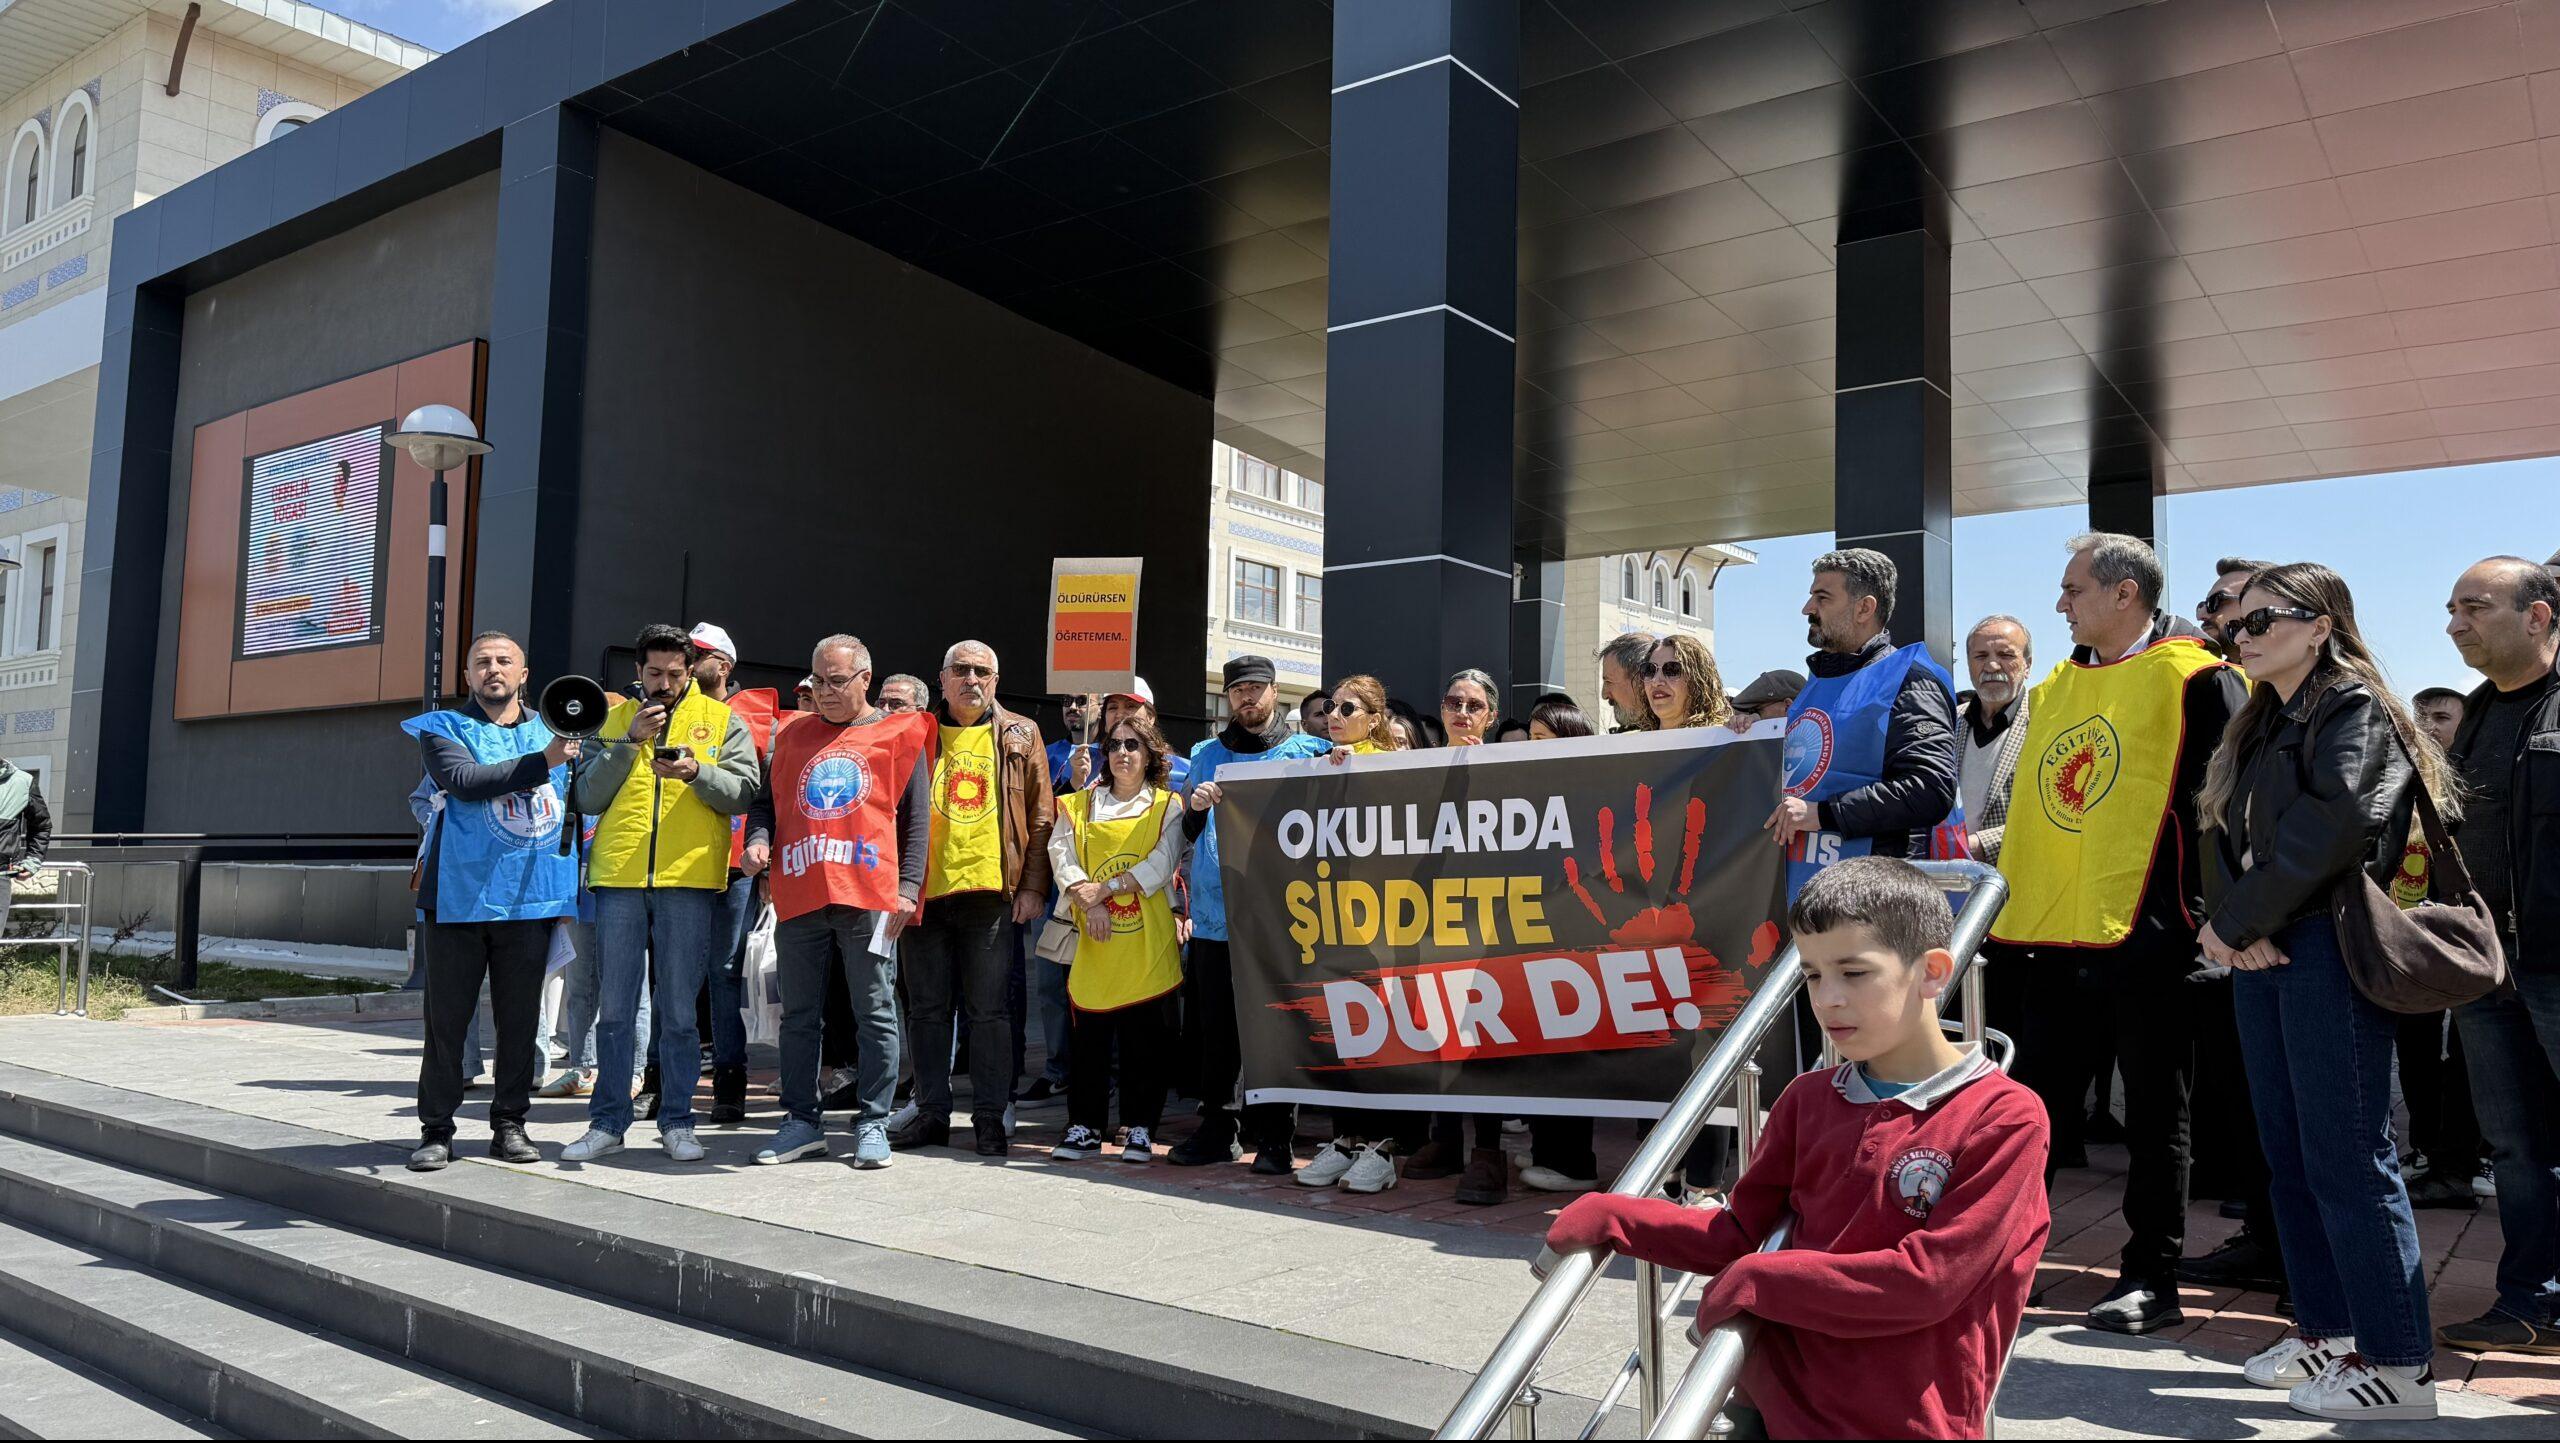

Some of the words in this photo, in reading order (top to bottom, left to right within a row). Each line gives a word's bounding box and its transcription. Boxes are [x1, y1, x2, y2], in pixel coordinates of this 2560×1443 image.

[1057, 591, 1126, 604] ÖLDÜRÜRSEN
[1055, 630, 1128, 641] ÖĞRETEMEM..
[1277, 795, 1574, 859] OKULLARDA
[1285, 860, 1555, 965] ŞİDDETE
[1323, 968, 1517, 1059] DUR
[1523, 946, 1702, 1040] DE!
[1890, 1155, 1909, 1179] YAVUZ
[1909, 1150, 1935, 1159] SELİM
